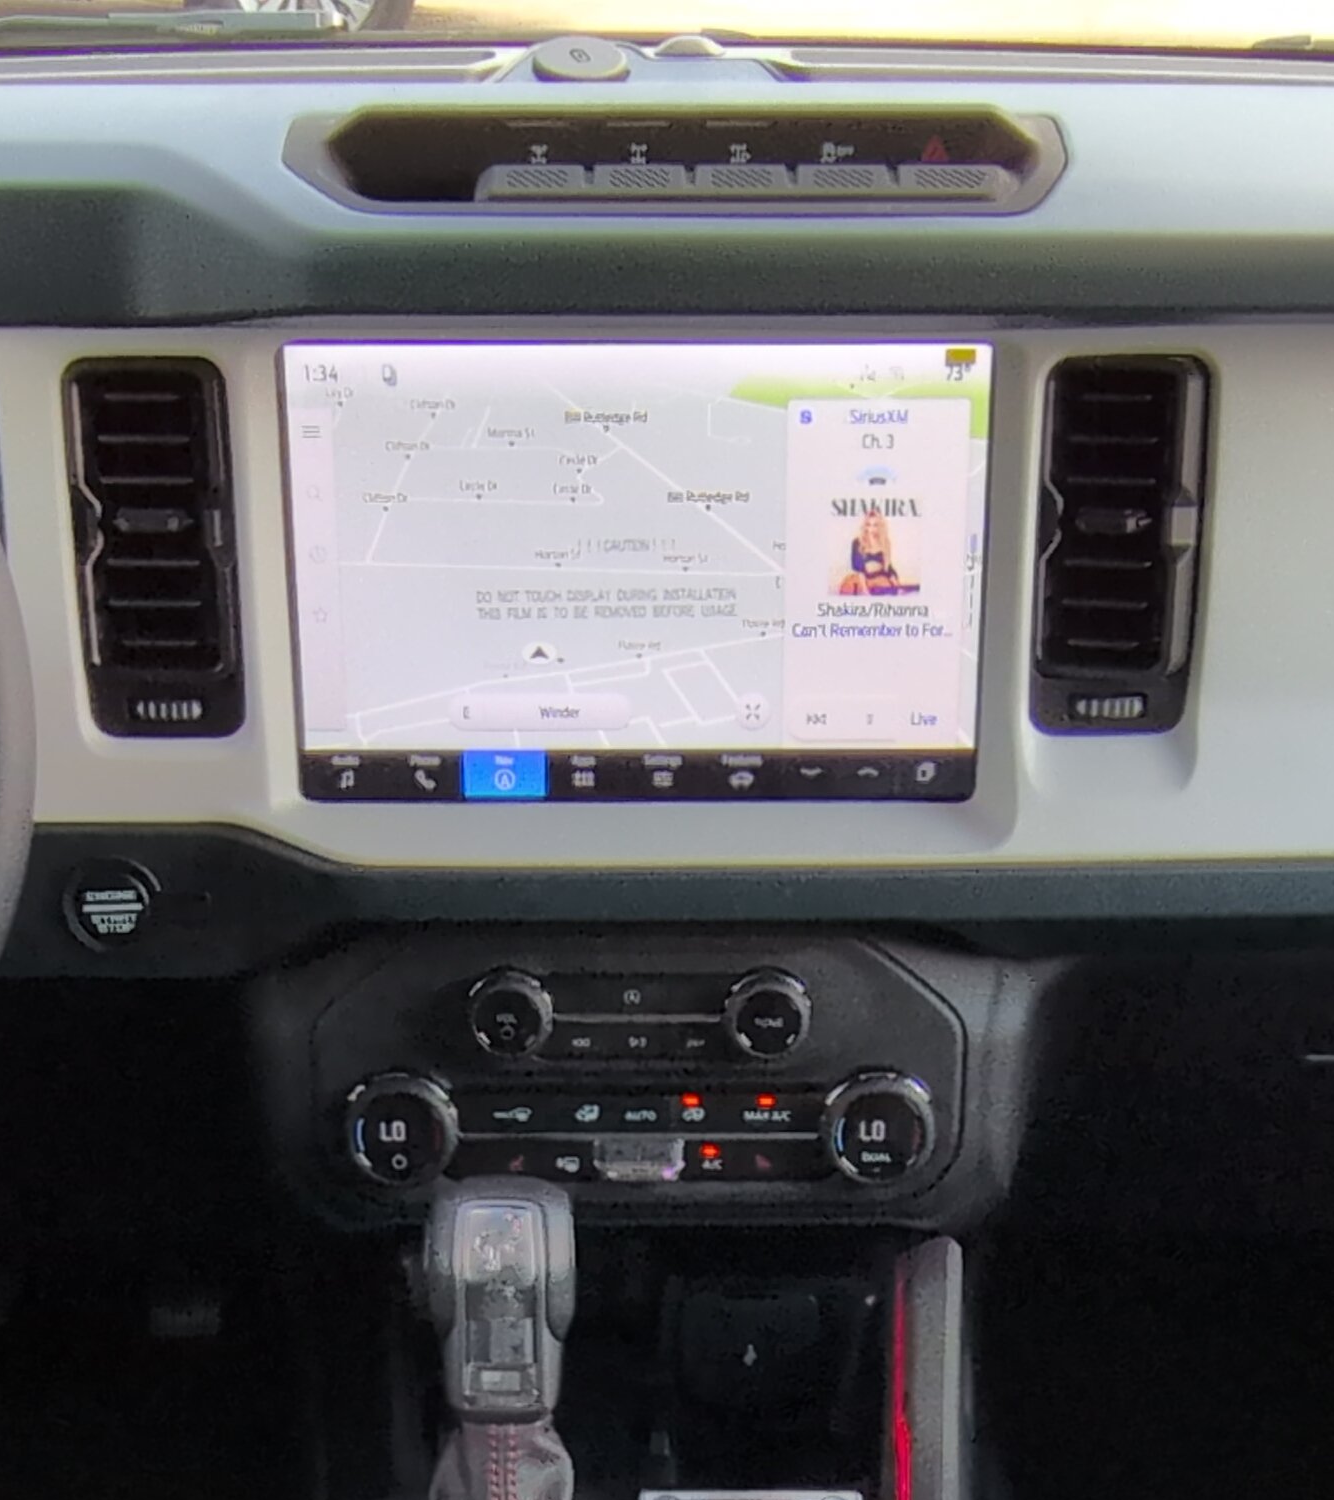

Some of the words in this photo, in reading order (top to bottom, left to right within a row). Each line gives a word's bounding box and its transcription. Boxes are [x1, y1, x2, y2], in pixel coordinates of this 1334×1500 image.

[304, 364, 339, 382] 1:34
[849, 409, 909, 424] SiriusXM
[886, 434, 895, 449] 3
[831, 498, 921, 518] SHAKIRA
[476, 591, 492, 603] DO
[497, 590, 519, 603] NOT
[525, 590, 562, 603] TOUCH
[567, 589, 611, 602] DISPLAY
[617, 589, 657, 602] DURING
[476, 607, 501, 621] THIS
[507, 607, 532, 620] FILM
[554, 606, 568, 619] TO
[574, 606, 588, 619] BE
[594, 605, 647, 619] REMOVED
[652, 605, 695, 618] BEFORE
[817, 602, 929, 618] Shakira/Rihanna
[792, 623, 827, 638] Can't
[830, 623, 903, 638] Remember
[905, 623, 918, 637] to
[539, 705, 580, 719] Winder
[910, 712, 937, 726] Live
